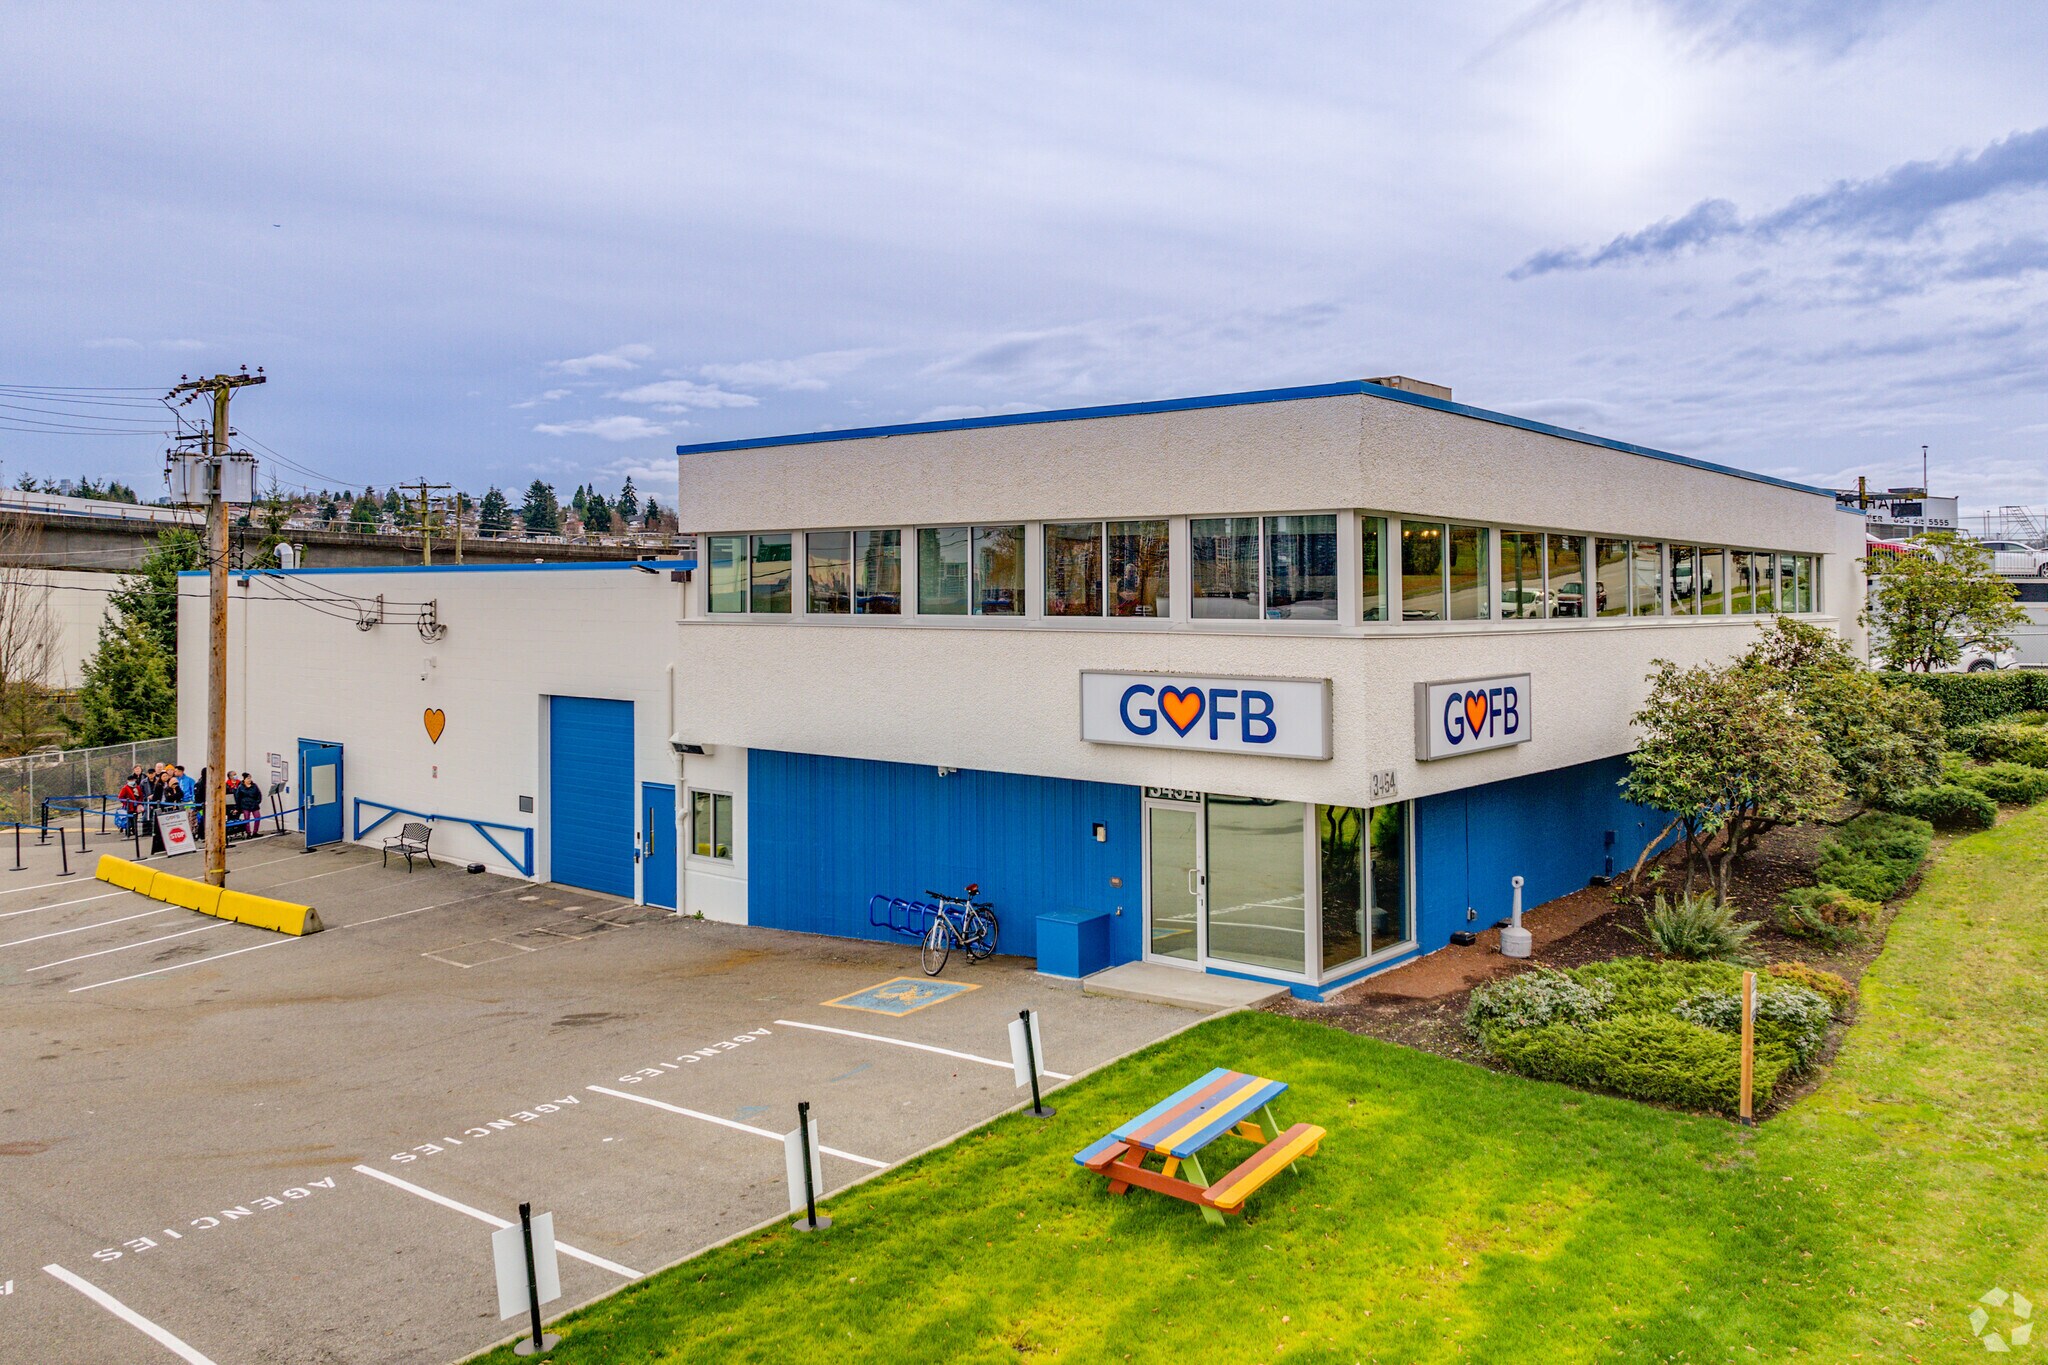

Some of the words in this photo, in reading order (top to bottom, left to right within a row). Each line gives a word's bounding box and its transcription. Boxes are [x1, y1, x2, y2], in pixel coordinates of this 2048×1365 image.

[1928, 518, 1950, 526] 5555
[1372, 772, 1396, 796] 3454
[170, 831, 185, 840] STOP
[618, 1027, 772, 1084] AGENCIES
[390, 1094, 580, 1163] AGENCIES
[92, 1176, 337, 1263] AGENCIES
